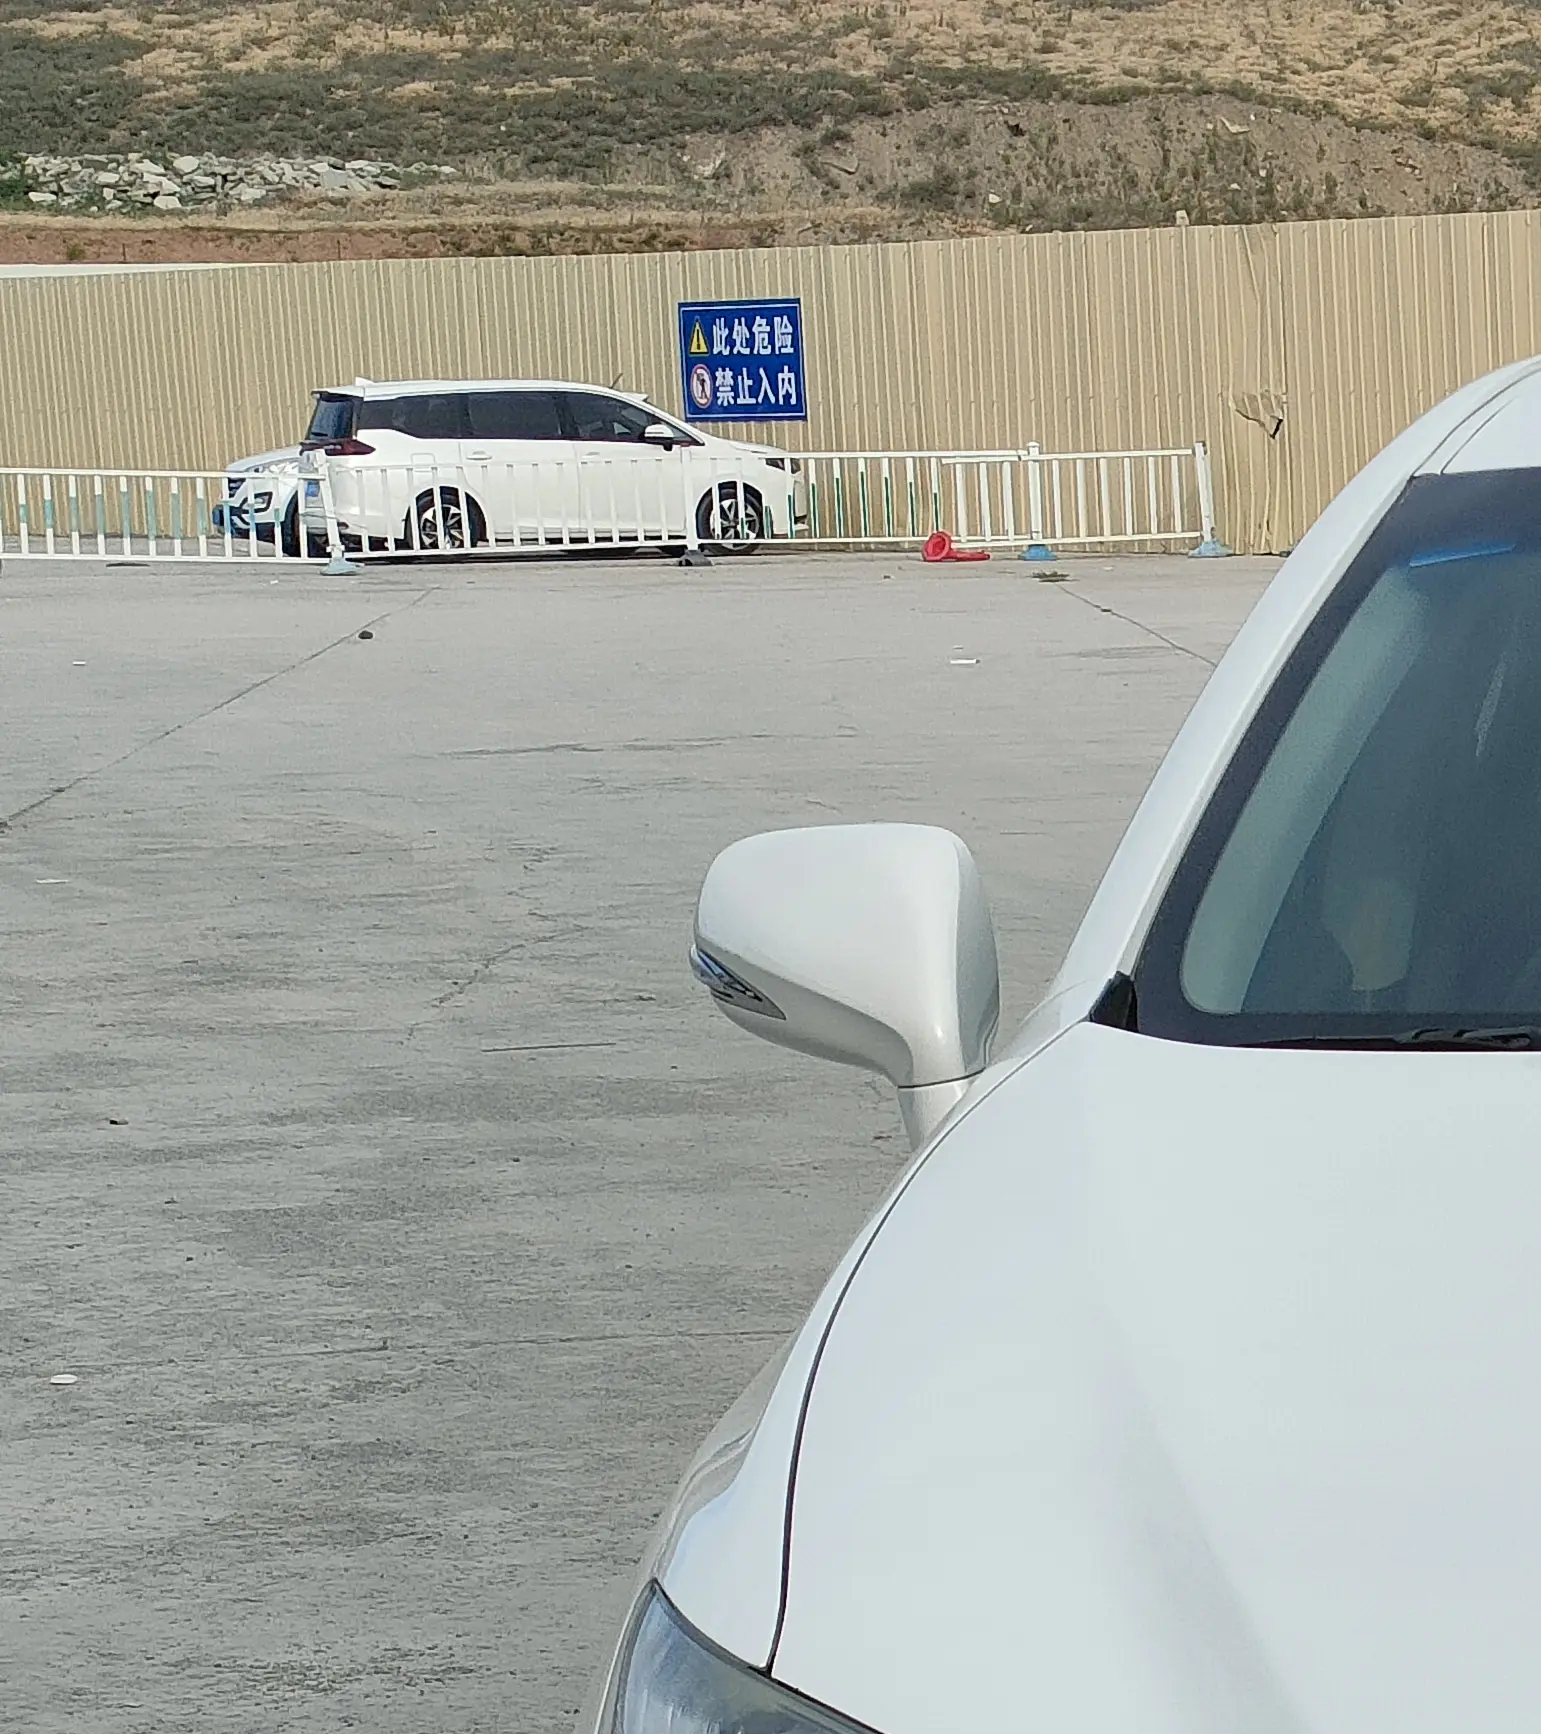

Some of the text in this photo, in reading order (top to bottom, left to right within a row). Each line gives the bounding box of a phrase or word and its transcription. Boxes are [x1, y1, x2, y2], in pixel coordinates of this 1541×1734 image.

[712, 315, 794, 356] 此处危险
[715, 364, 797, 407] 禁止入内
